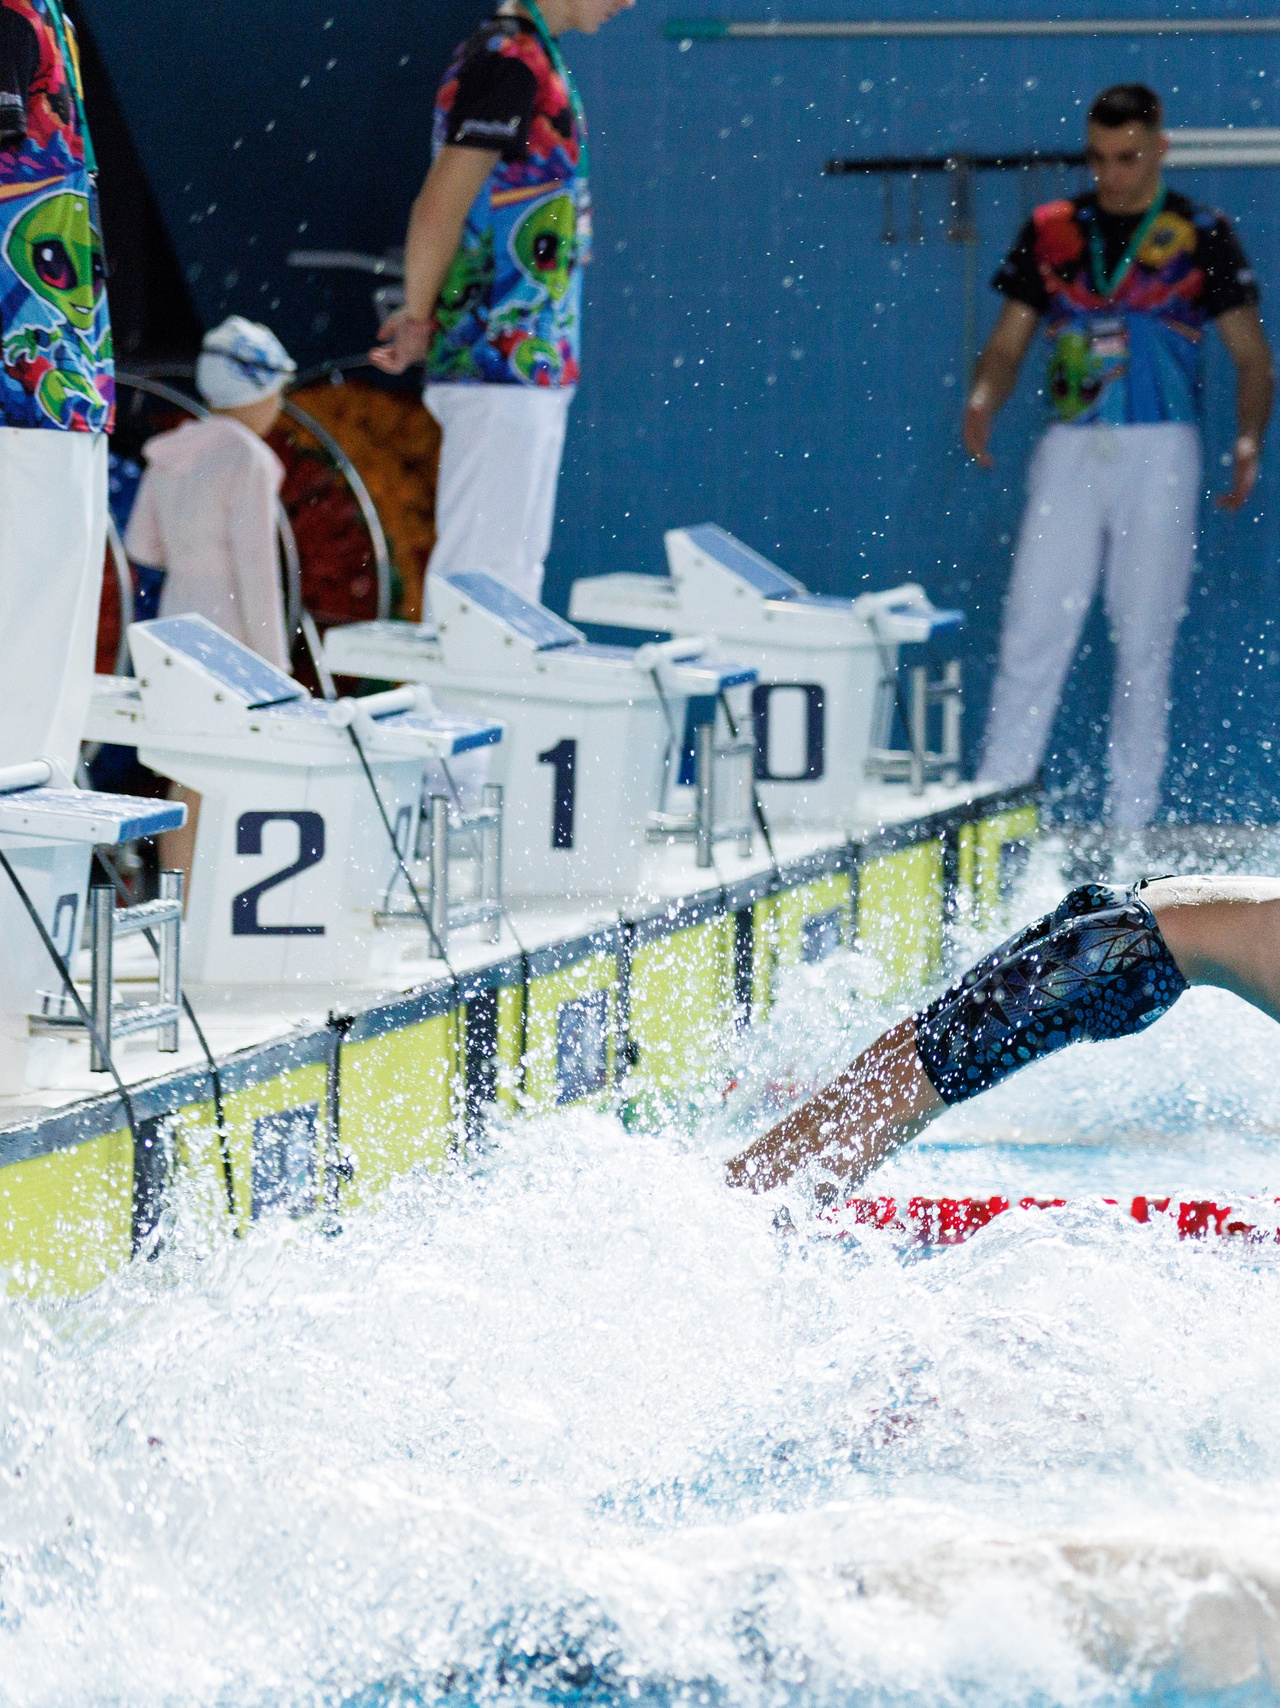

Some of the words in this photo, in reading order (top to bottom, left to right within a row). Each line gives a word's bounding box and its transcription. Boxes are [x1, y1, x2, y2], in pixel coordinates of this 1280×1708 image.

[752, 683, 824, 781] 0
[538, 739, 577, 848] 1
[232, 811, 325, 935] 2
